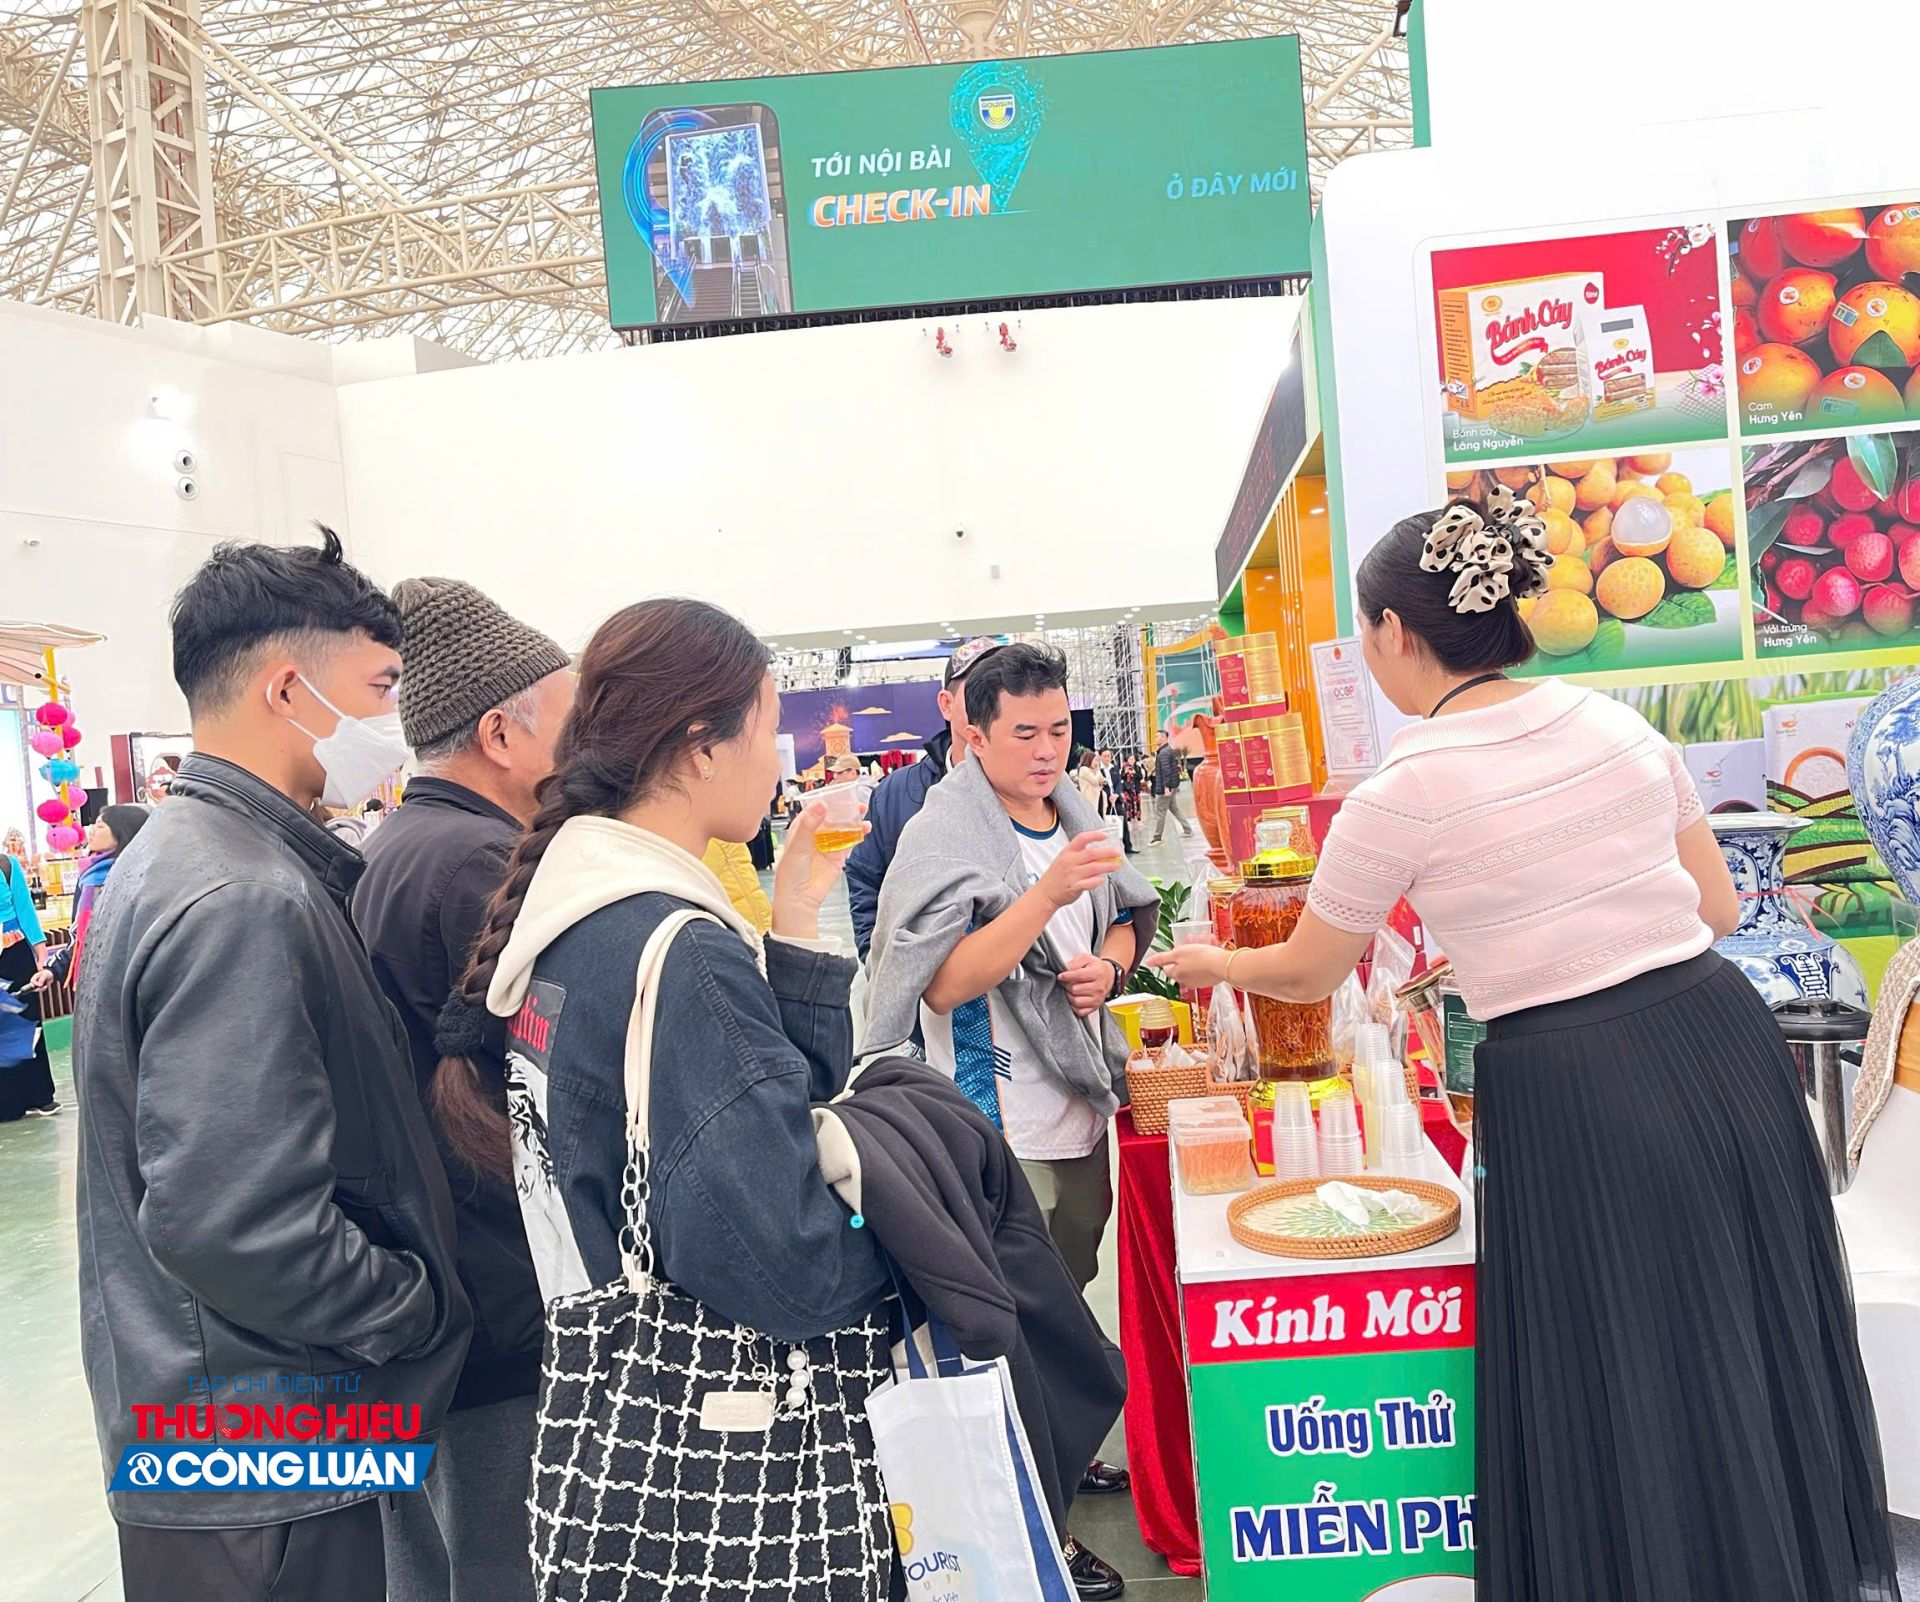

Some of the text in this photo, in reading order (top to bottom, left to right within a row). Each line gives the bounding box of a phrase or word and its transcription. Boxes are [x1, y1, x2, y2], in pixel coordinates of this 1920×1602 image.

[811, 144, 951, 178] TỚI NỘI BÀI
[1166, 166, 1297, 199] Ở ĐÂY MỚI
[812, 184, 991, 228] CHECK-IN
[1486, 307, 1540, 349] Bánh
[1538, 298, 1573, 330] Cáy
[1748, 402, 1773, 411] Cam
[1749, 411, 1803, 425] Hưng Yên
[1452, 428, 1478, 439] Bánh
[1763, 634, 1817, 648] Hưng Yên
[1211, 1286, 1462, 1348] Kính Mời
[1267, 1393, 1454, 1455] Uống Thử
[1234, 1485, 1478, 1558] MIỄN PH
